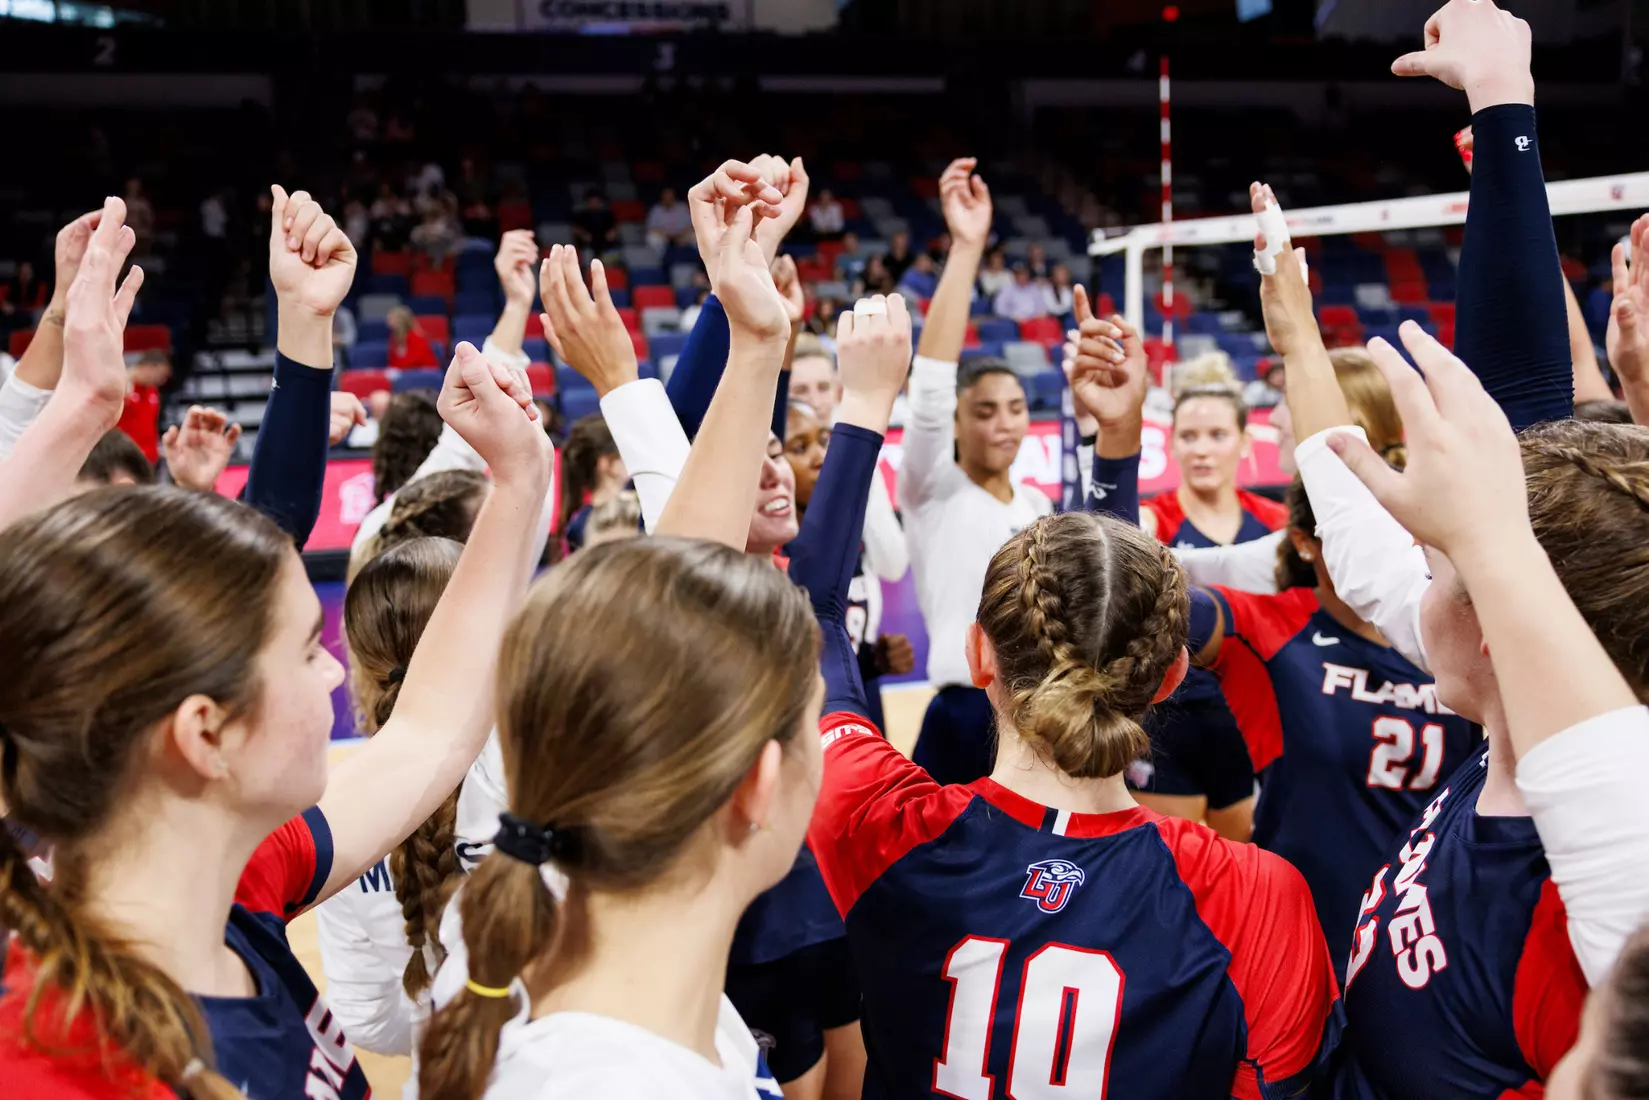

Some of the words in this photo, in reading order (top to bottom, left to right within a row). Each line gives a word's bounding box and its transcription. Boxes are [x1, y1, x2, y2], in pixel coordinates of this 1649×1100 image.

[93, 36, 116, 66] 2
[1366, 714, 1445, 791] 21
[1019, 860, 1079, 914] LU
[931, 934, 1126, 1100] 10
